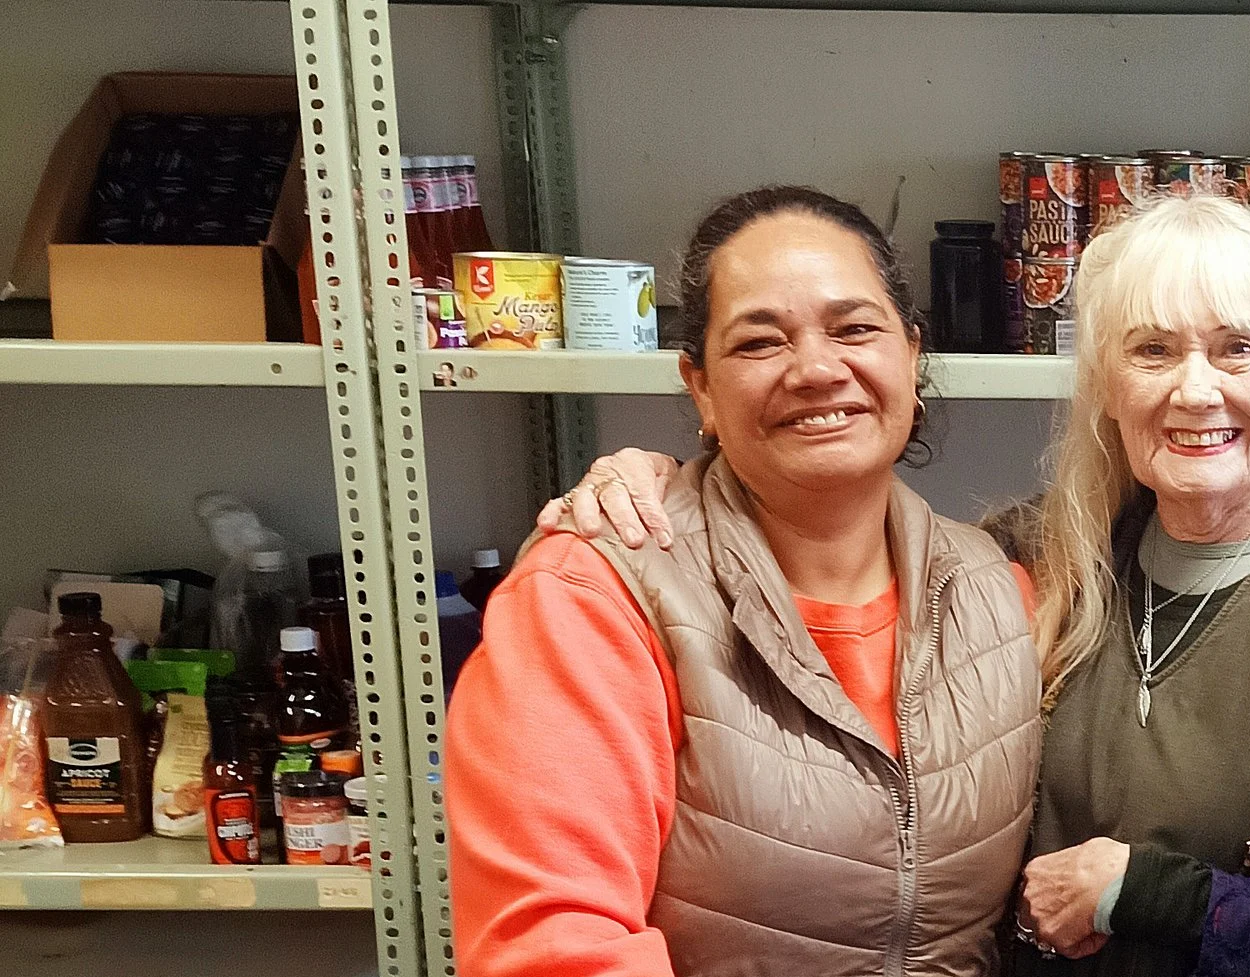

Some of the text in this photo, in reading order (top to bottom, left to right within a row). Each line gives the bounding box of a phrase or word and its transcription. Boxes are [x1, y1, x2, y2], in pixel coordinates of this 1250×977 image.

[1029, 200, 1077, 220] PASTA
[493, 296, 558, 317] Mango
[61, 769, 111, 777] APRICOT
[70, 779, 102, 788] SAUCE
